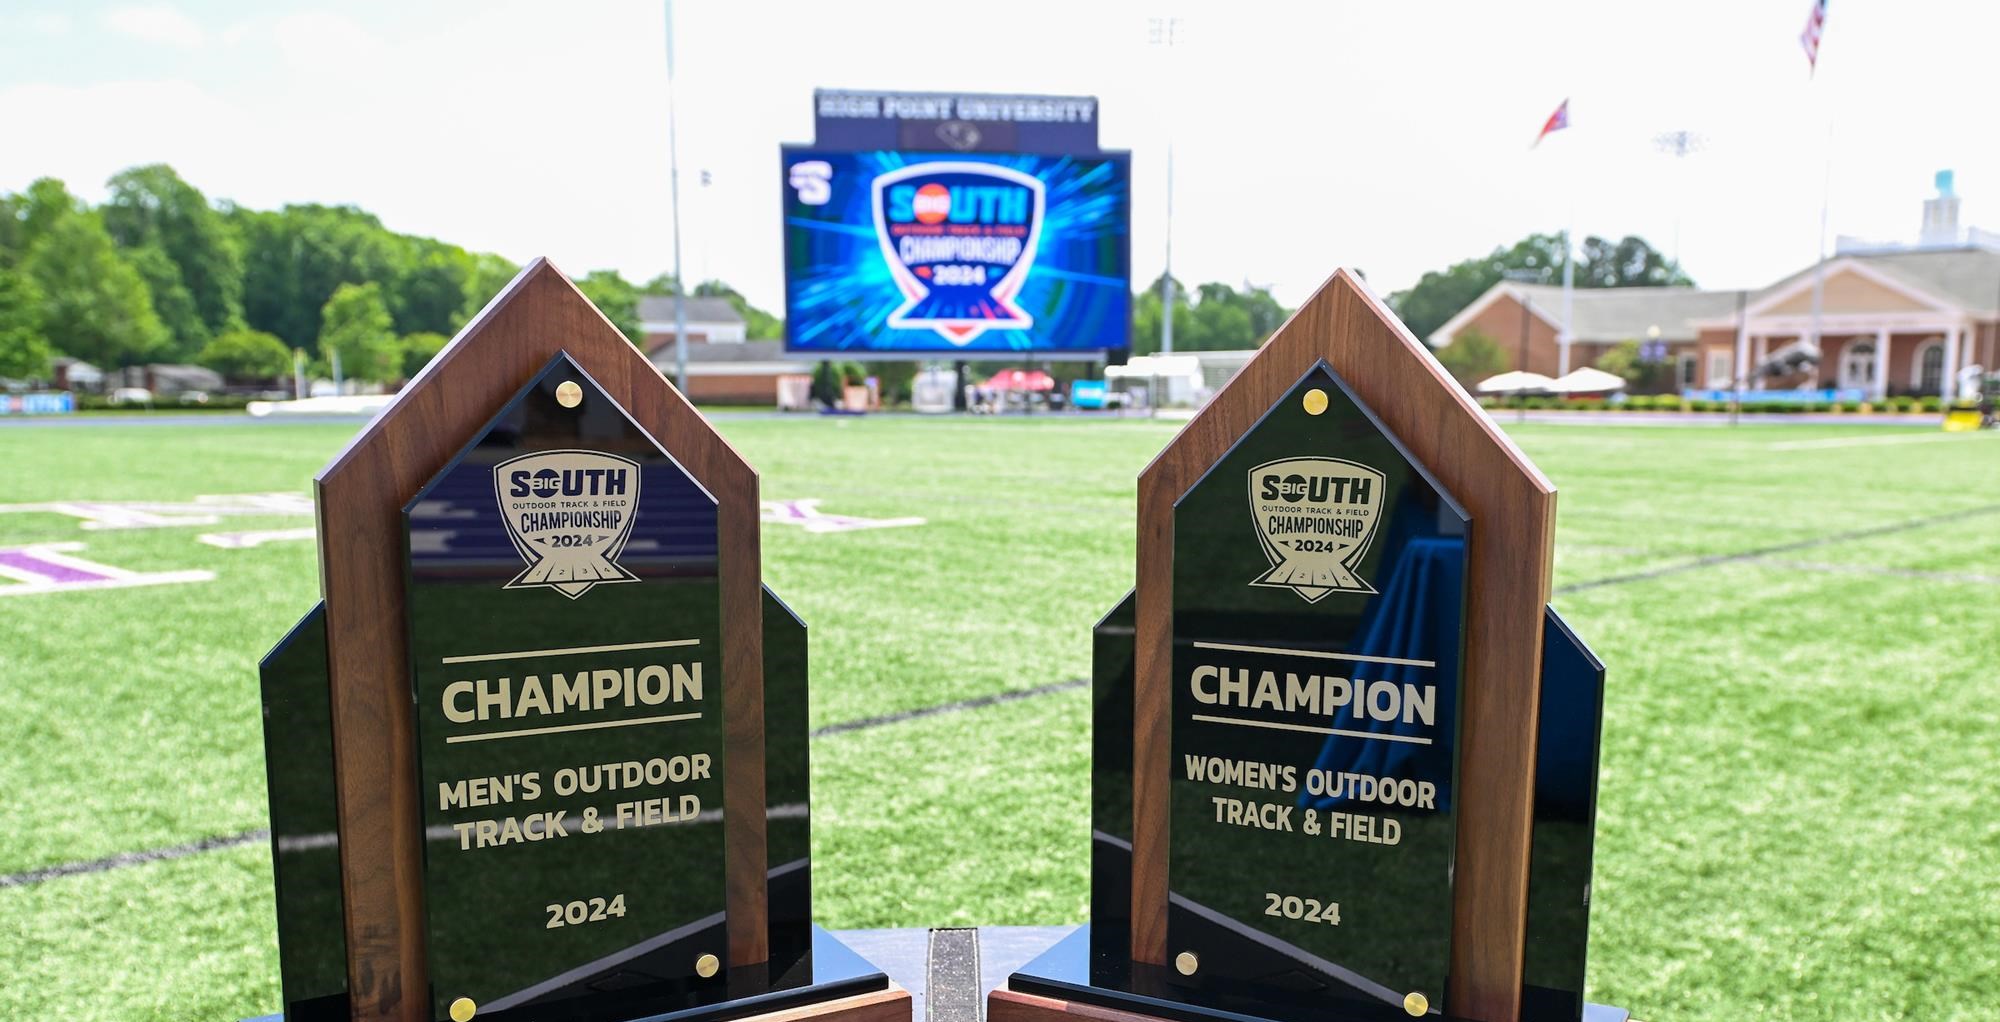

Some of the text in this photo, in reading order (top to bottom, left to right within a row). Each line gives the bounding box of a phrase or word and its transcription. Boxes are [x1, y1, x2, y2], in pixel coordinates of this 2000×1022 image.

[883, 96, 951, 120] POINT
[956, 99, 1094, 123] UNIVERSITY
[510, 469, 626, 498] SOUTH
[1261, 474, 1372, 504] SOUTH
[512, 501, 556, 510] OUTDOOR
[560, 501, 589, 509] TRACK
[602, 499, 627, 507] FIELD
[1262, 505, 1302, 514] OUTDOOR
[1306, 507, 1332, 515] TRACK
[1346, 509, 1369, 517] FIELD
[521, 510, 622, 534] CHAMPIONSHIP
[1268, 515, 1364, 539] CHAMPIONSHIP
[551, 534, 593, 548] 2024
[1294, 539, 1334, 553] 2024
[442, 661, 703, 723] CHAMPION
[1190, 665, 1437, 726] CHAMPION
[438, 753, 712, 811] MEN'S OUTDOOR
[1184, 754, 1436, 810] WOMEN'S OUTDOOR
[453, 794, 701, 851] TRACK & FIELD
[1212, 796, 1402, 846] TRACK & FIELD
[546, 893, 627, 929] 2024
[1264, 892, 1341, 927] 2024
